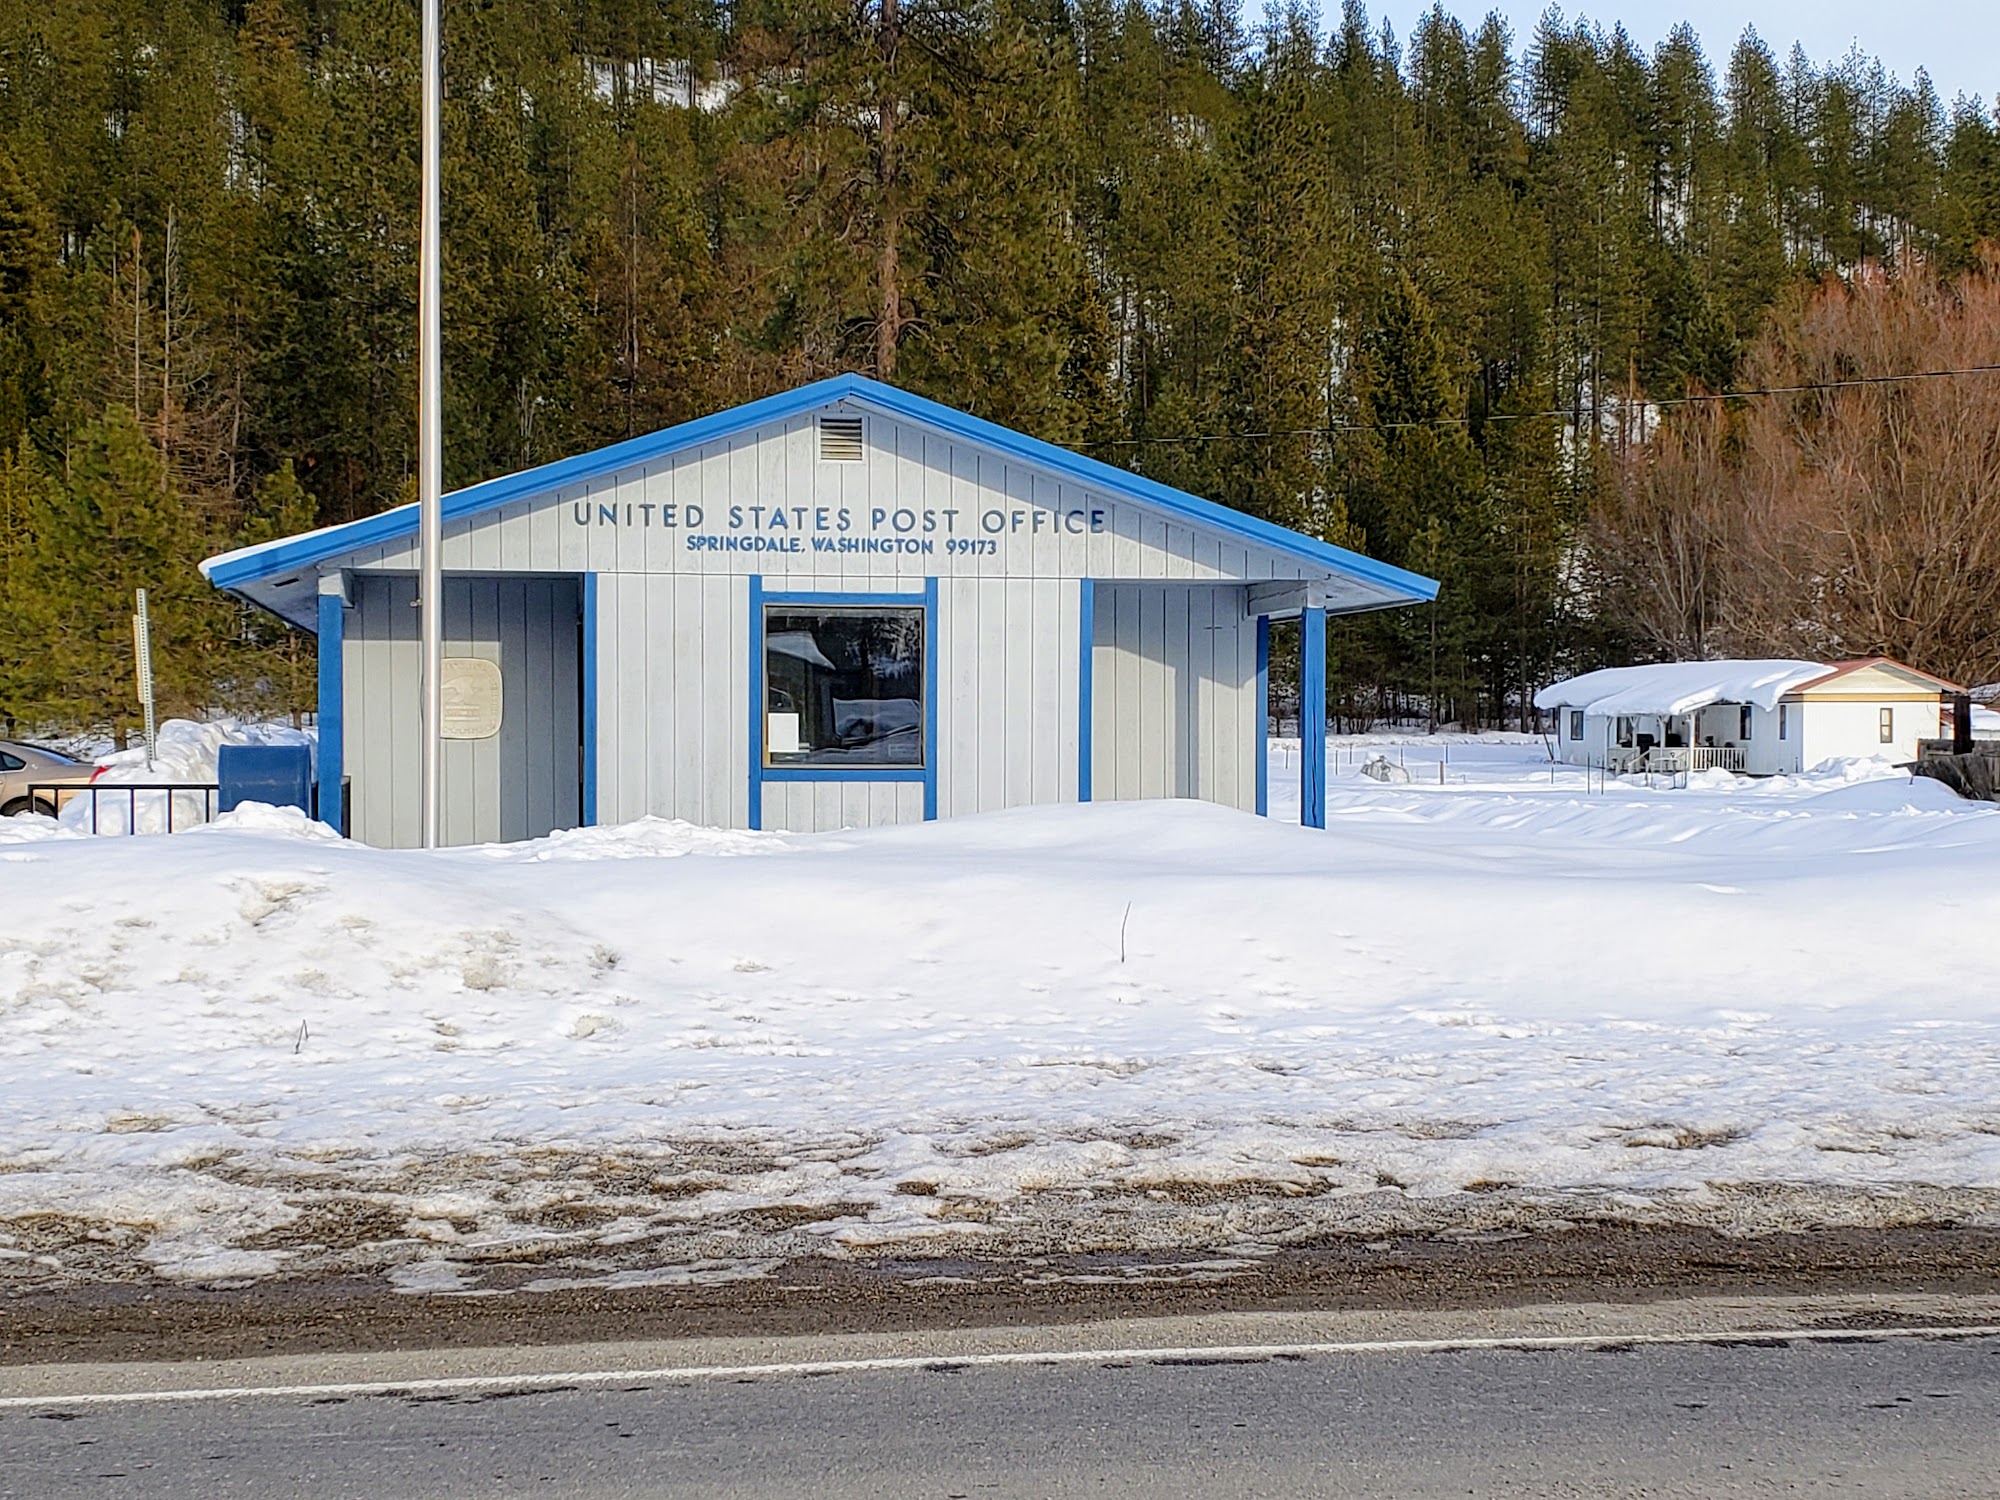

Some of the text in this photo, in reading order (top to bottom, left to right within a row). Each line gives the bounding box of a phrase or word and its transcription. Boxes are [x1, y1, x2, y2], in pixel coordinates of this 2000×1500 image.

[573, 502, 1106, 534] UNITED STATES POST OFFICE
[686, 535, 997, 556] SPRINGDALE, WASHINGTON 99173
